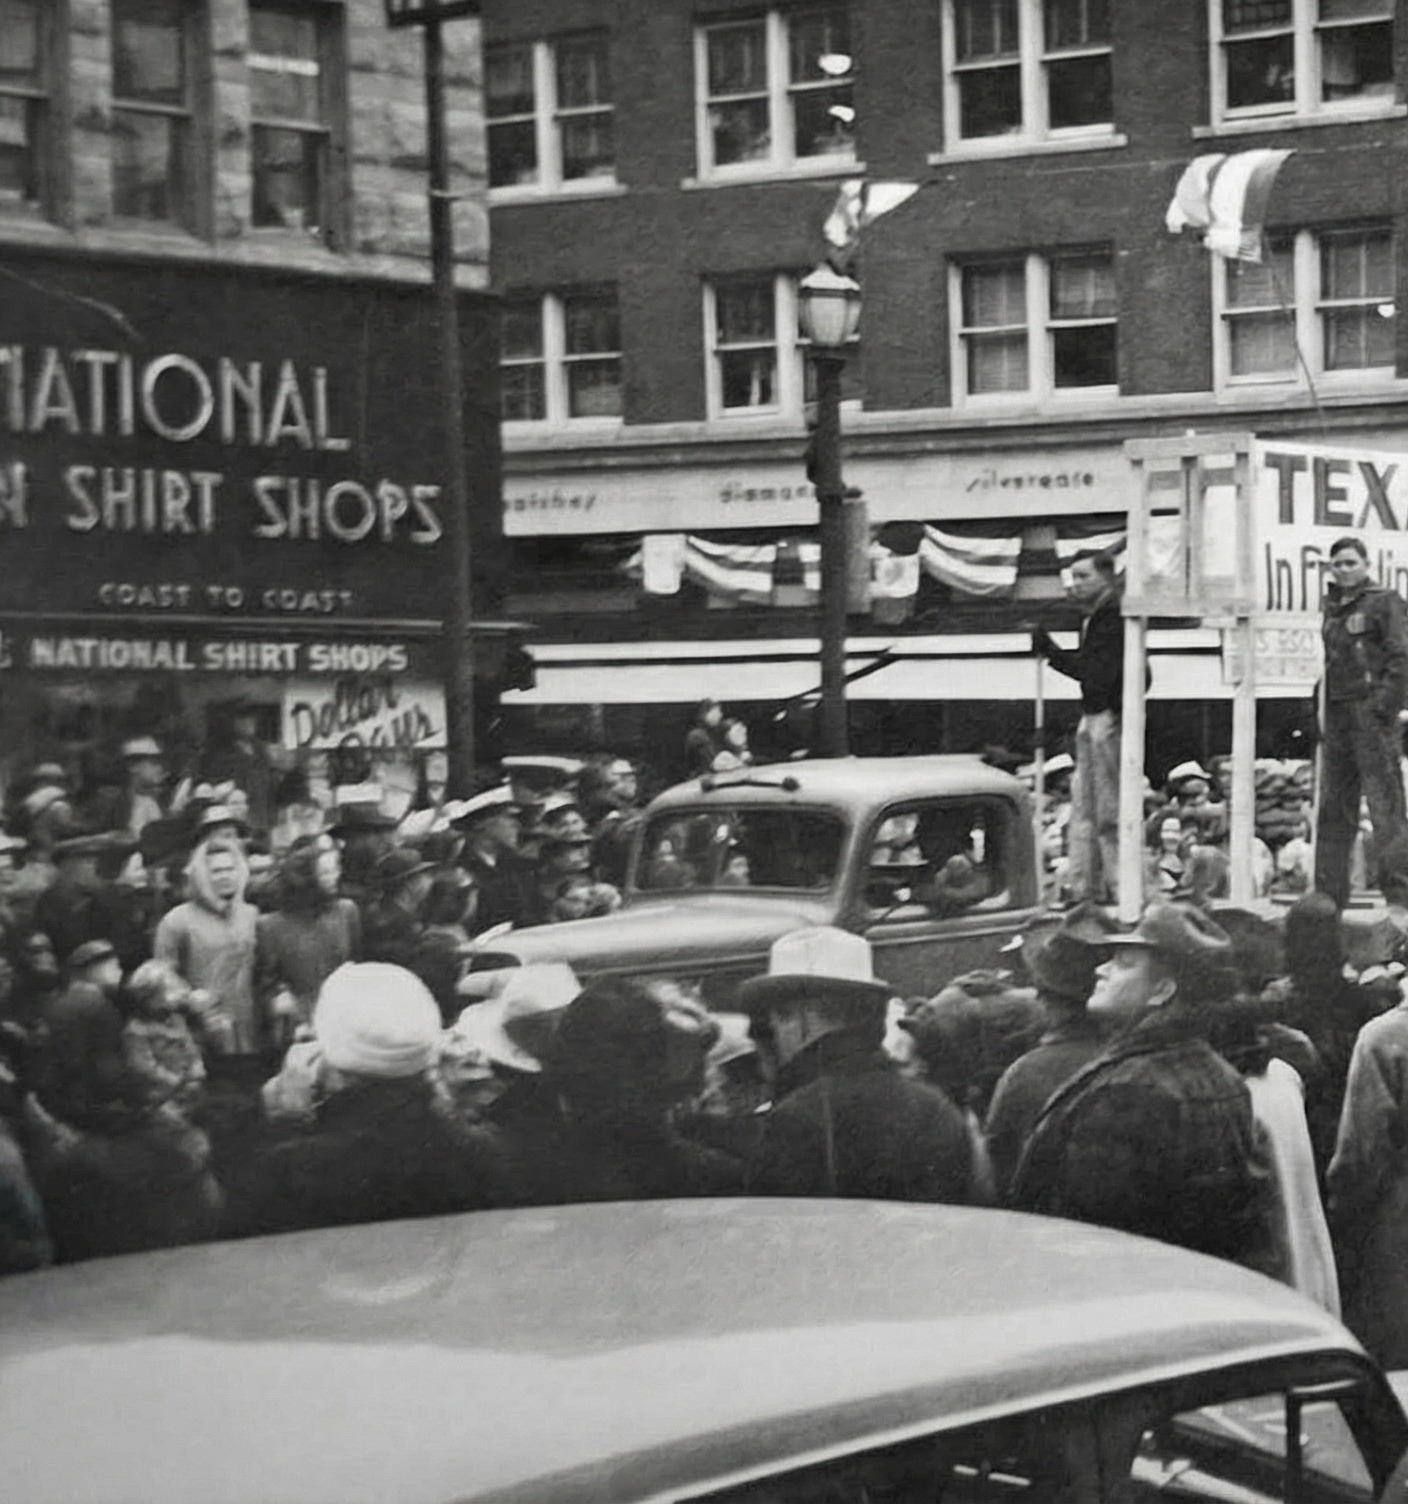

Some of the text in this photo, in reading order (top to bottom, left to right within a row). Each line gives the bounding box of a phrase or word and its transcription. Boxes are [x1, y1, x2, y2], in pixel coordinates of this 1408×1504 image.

[65, 464, 225, 532] SHIRT
[252, 475, 443, 544] SHOPS
[99, 582, 352, 612] COAST TO COAST
[1265, 542, 1293, 612] In
[30, 637, 196, 669] NATIONAL
[203, 642, 300, 670] SHIRT
[308, 644, 408, 671] SHOPS
